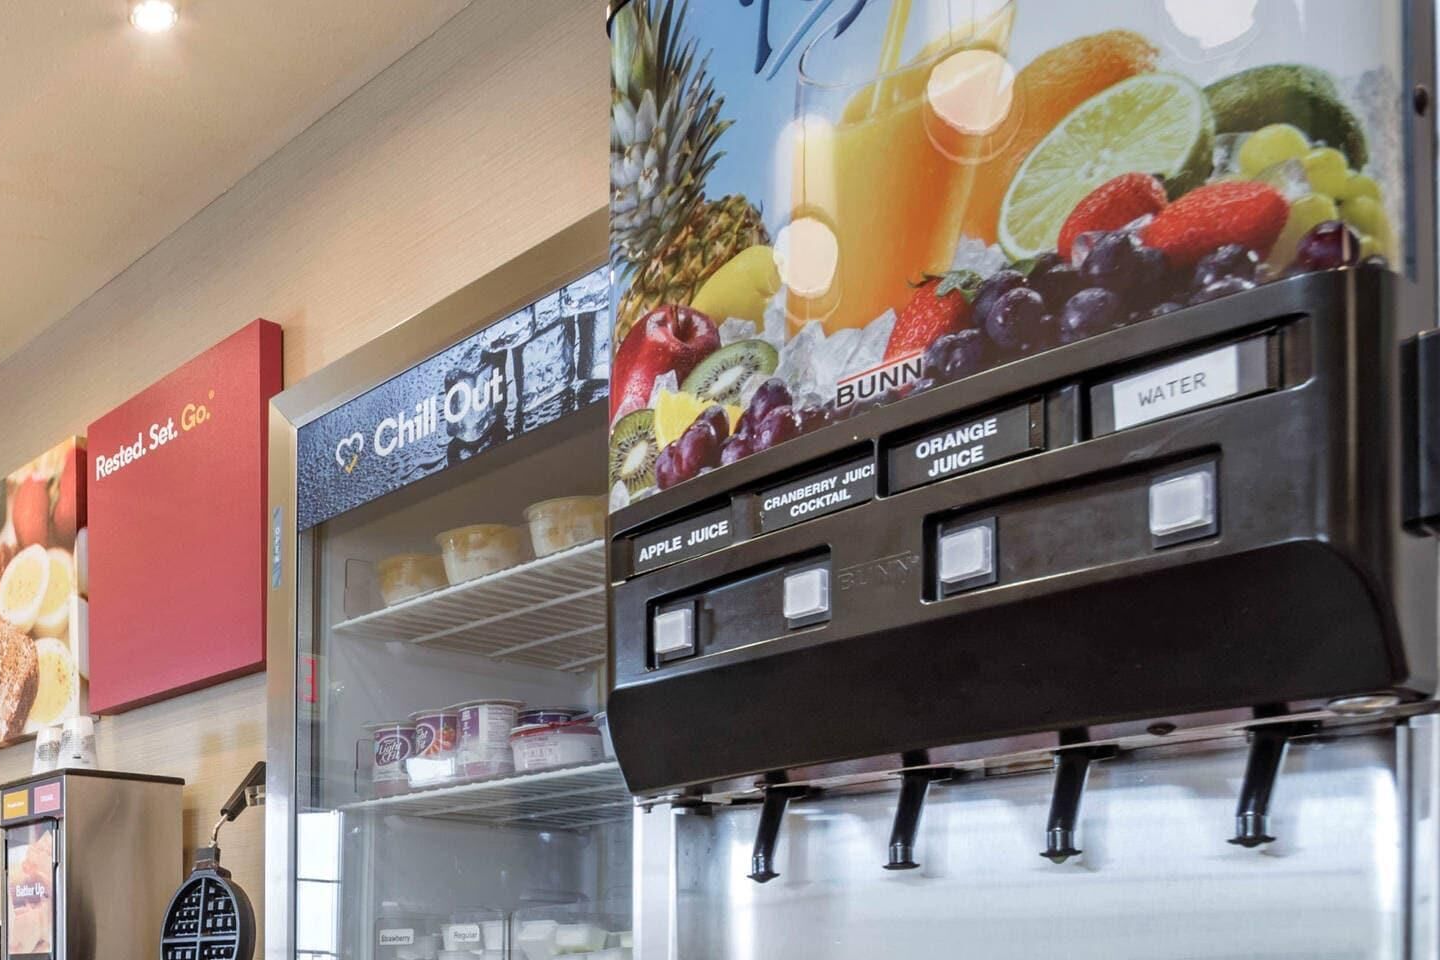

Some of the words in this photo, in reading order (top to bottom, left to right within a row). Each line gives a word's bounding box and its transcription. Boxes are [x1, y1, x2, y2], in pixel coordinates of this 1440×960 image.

[836, 357, 923, 408] BUNN
[1137, 371, 1207, 408] WATER
[374, 396, 438, 457] Chill
[443, 366, 504, 424] Out
[95, 432, 147, 481] Rested.
[148, 416, 179, 450] Set.
[915, 417, 998, 459] ORANGE
[927, 445, 985, 477] JUICE
[763, 474, 839, 512] CRANBERRY
[789, 488, 852, 518] COCKTAIL
[638, 535, 683, 563] APPLE
[686, 519, 730, 547] JUICE
[15, 884, 35, 898] Batter
[35, 882, 46, 898] Up
[381, 934, 411, 943] Strawberry
